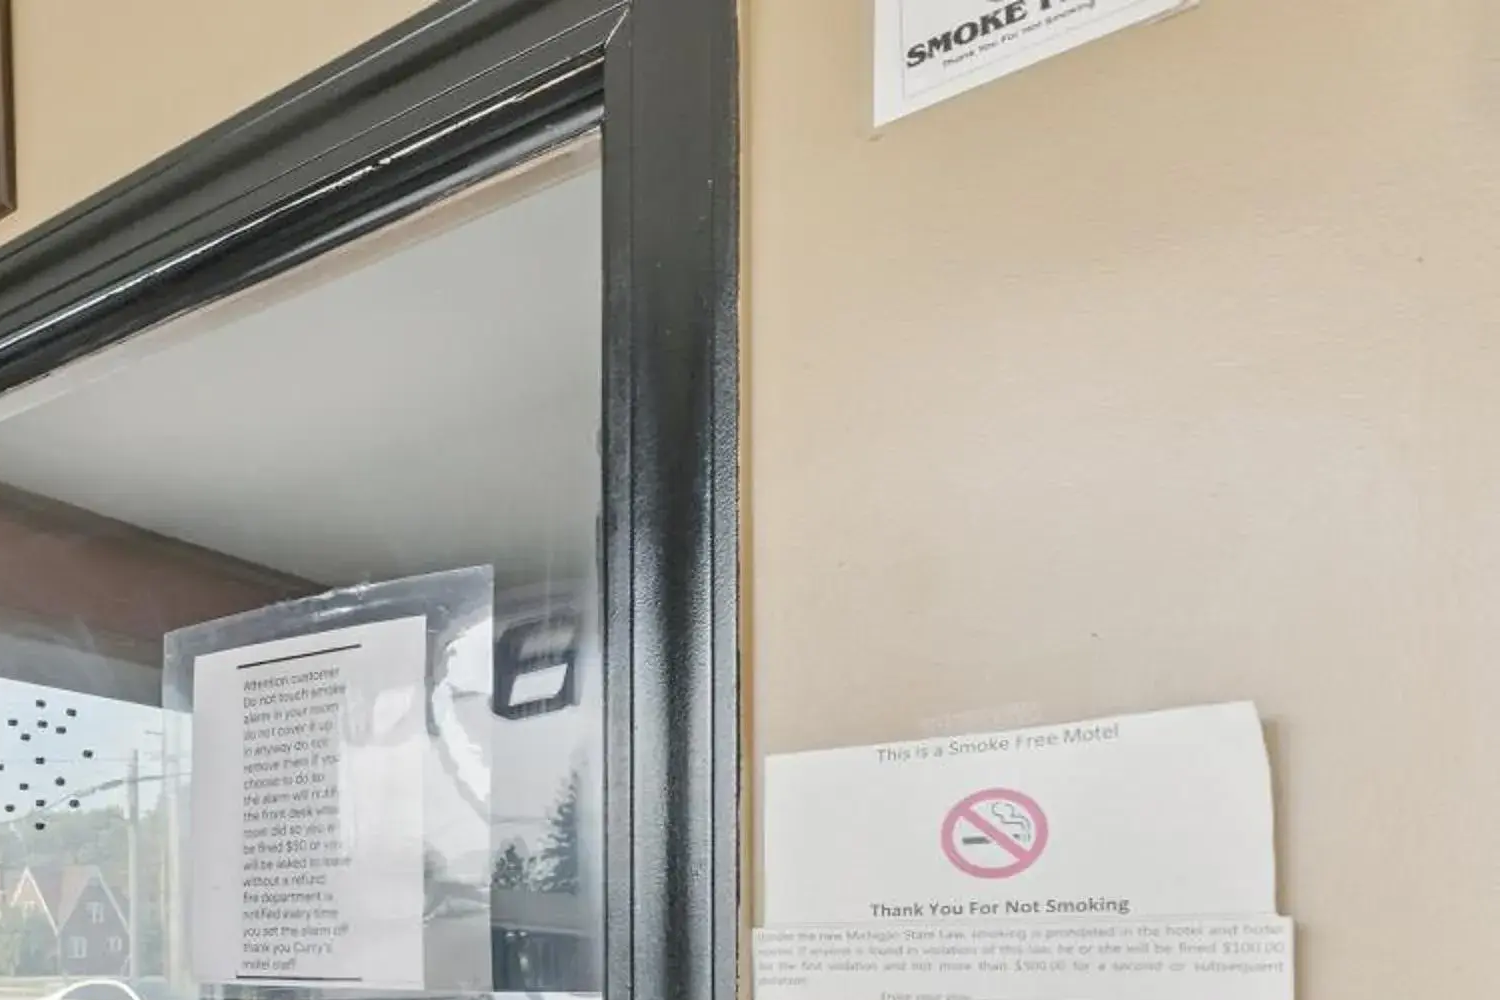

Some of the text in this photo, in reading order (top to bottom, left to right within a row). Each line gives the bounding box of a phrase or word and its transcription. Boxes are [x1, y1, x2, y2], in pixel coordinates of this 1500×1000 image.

[906, 0, 1028, 68] SMOKE
[244, 675, 289, 692] Attention
[259, 694, 277, 706] not
[279, 688, 309, 703] touch
[876, 722, 1120, 765] This is a Smoke Free Motel
[869, 896, 1131, 918] Thank You For Not Smoking
